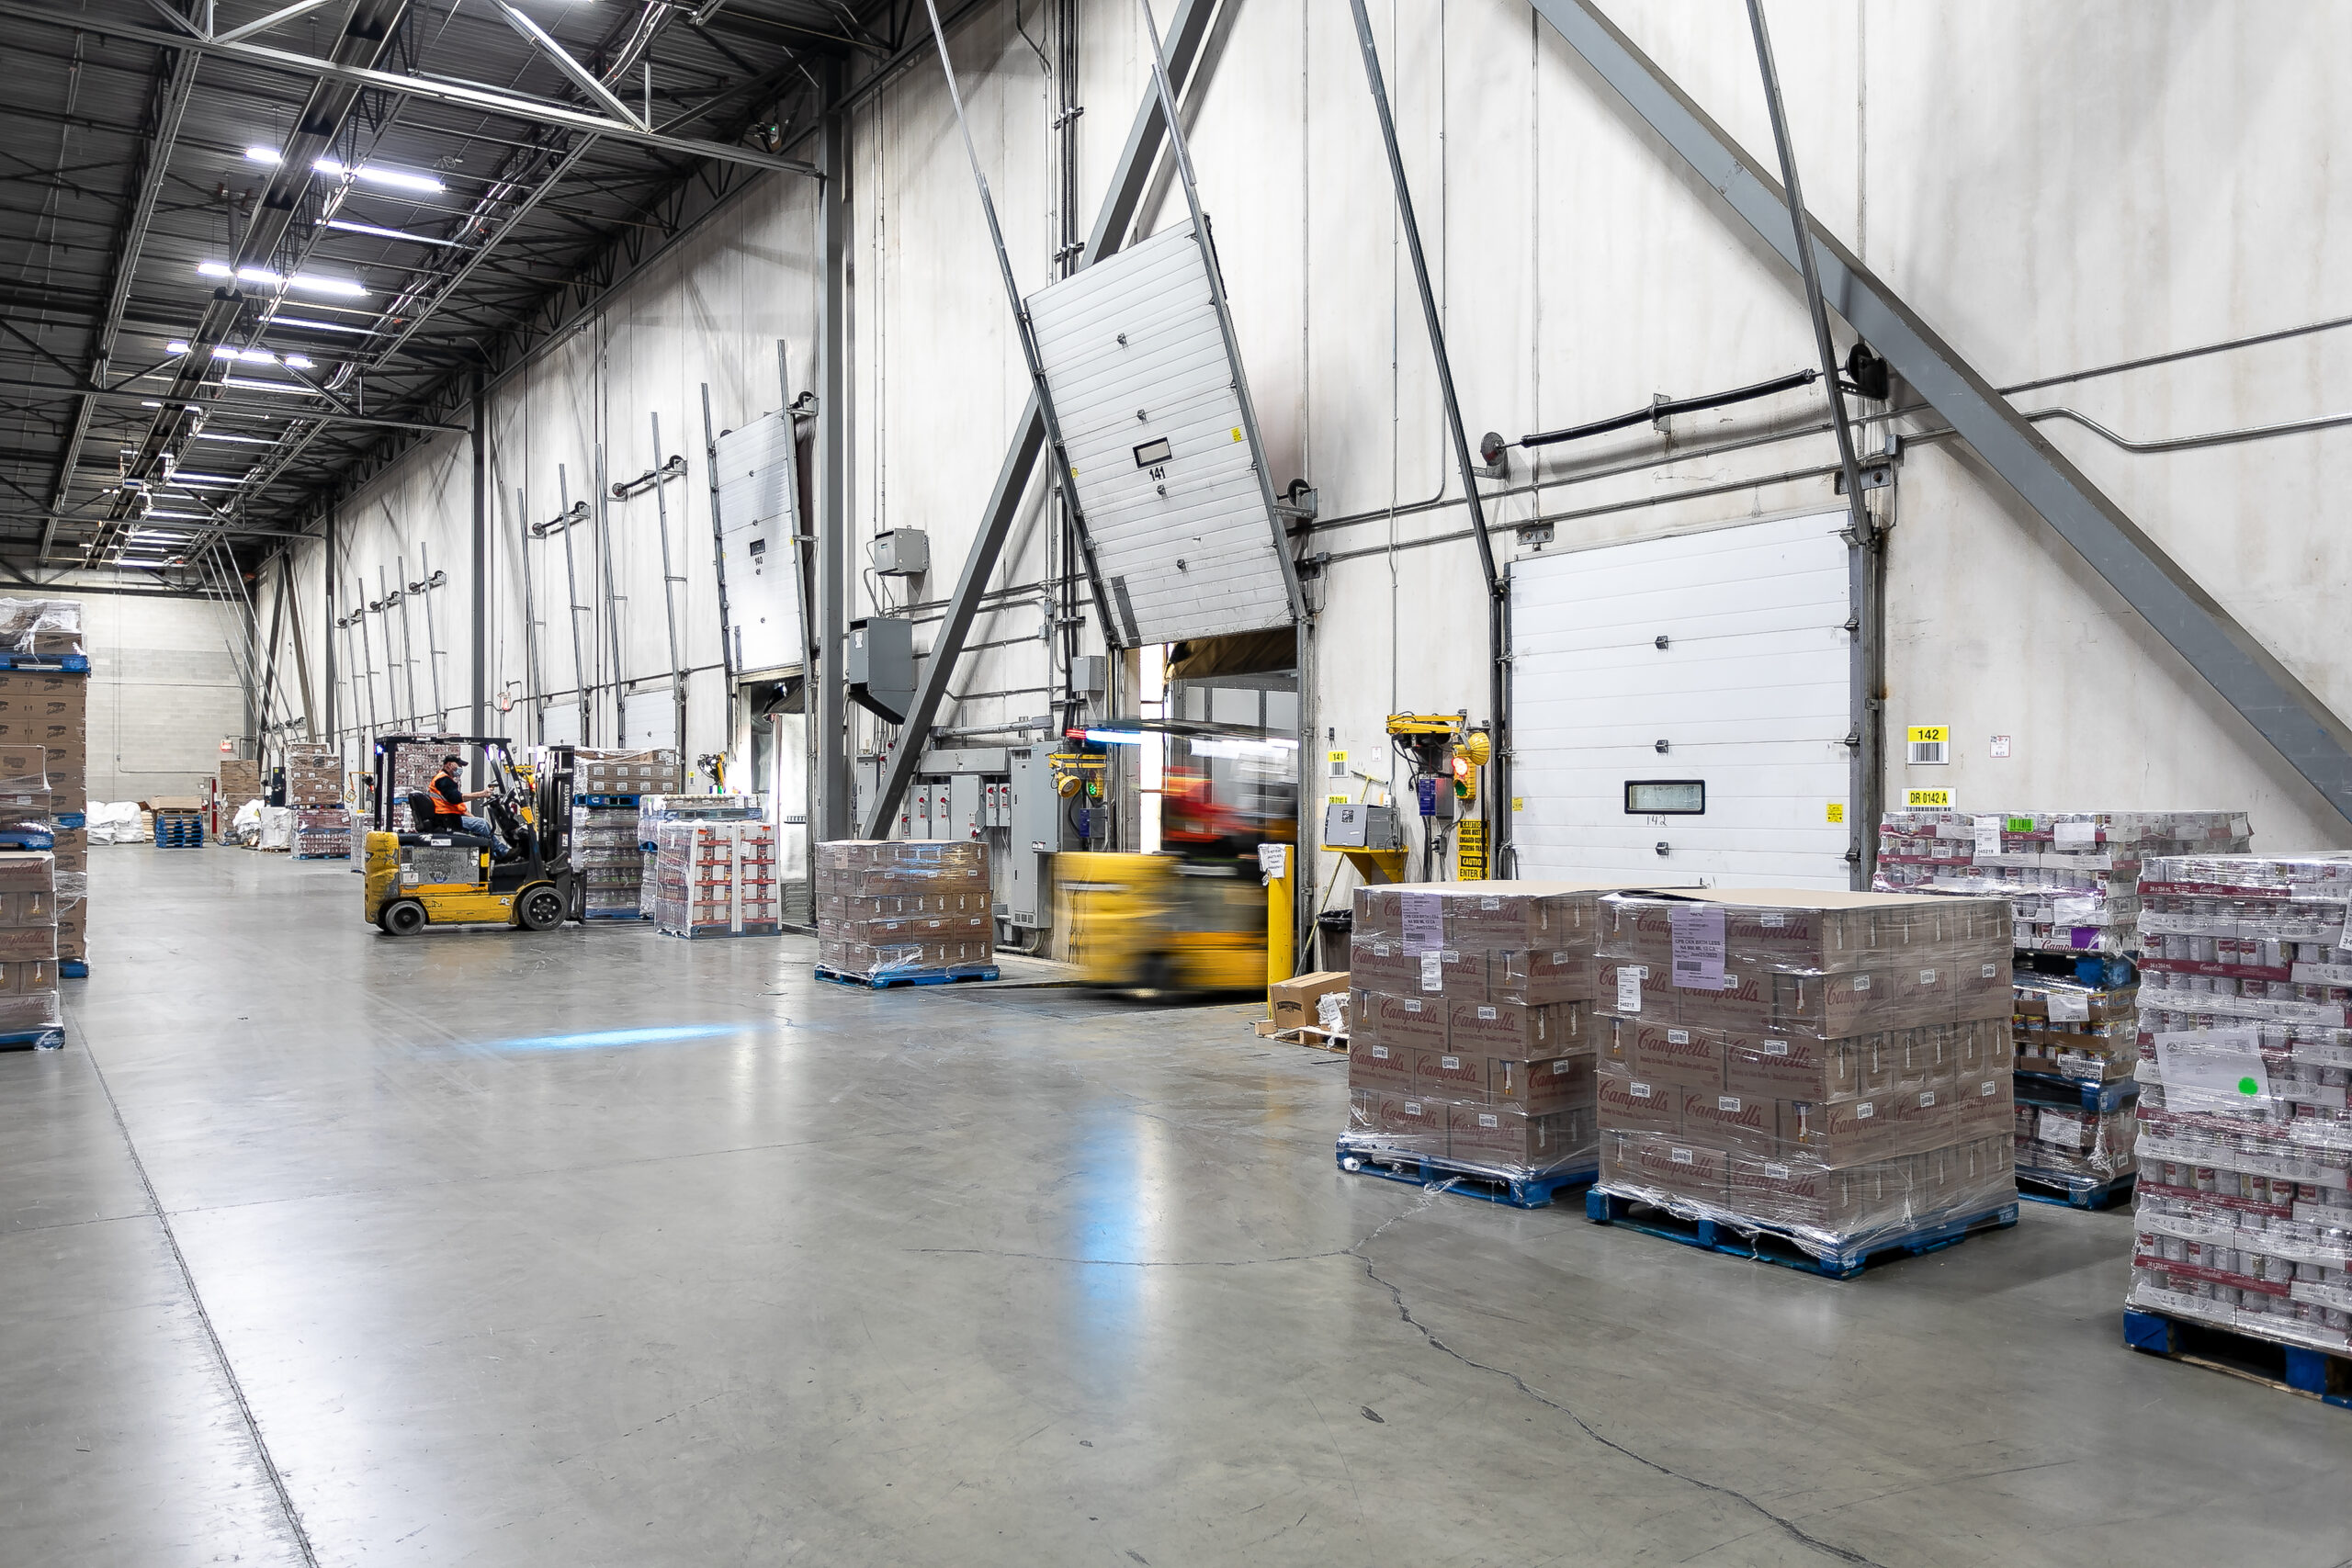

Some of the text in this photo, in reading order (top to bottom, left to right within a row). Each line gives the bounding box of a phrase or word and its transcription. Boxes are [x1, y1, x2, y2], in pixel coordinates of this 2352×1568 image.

[1149, 466, 1166, 481] 141
[1917, 729, 1939, 740] 142
[1332, 752, 1343, 761] 141
[1910, 793, 1948, 804] DR 0142 A
[1646, 815, 1668, 827] 142
[1463, 857, 1482, 866] CAUTIO
[1460, 868, 1478, 878] ENTER
